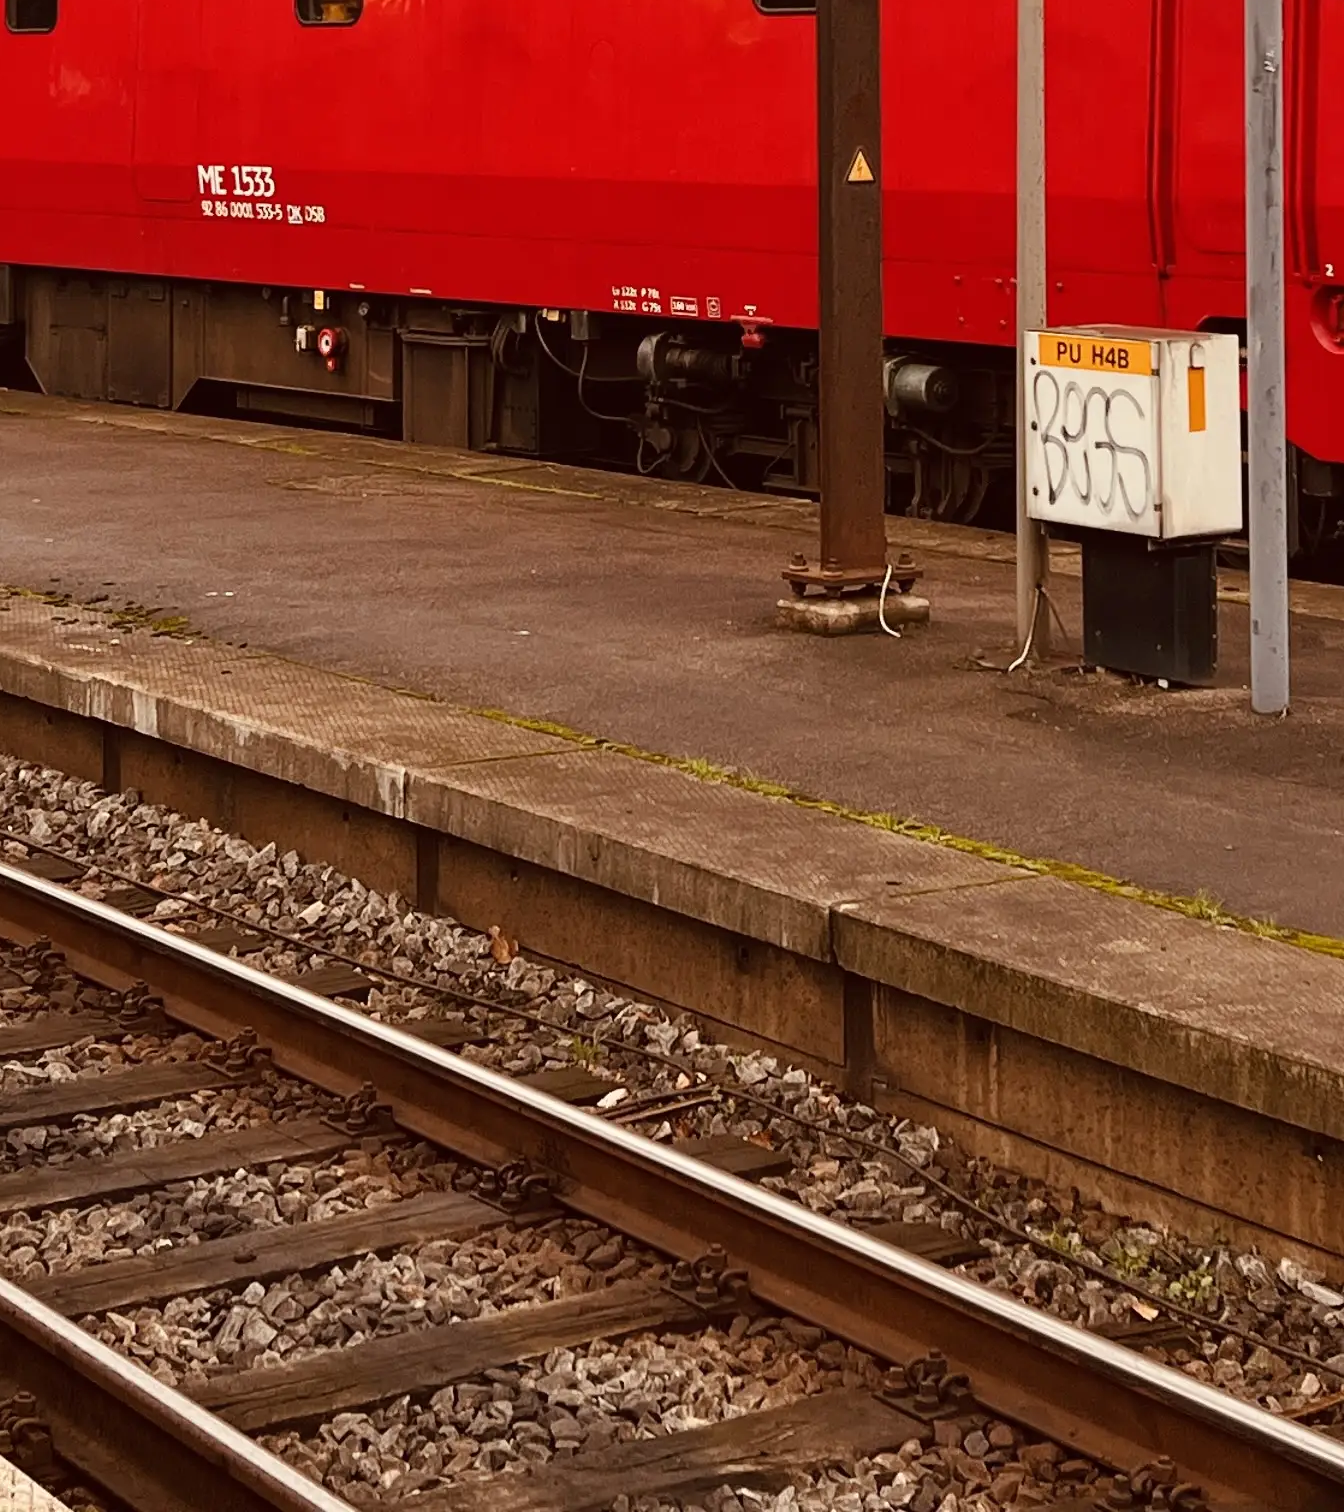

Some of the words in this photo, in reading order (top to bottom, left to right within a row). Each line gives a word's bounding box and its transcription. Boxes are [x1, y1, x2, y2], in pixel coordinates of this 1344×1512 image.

[197, 164, 227, 195] ME
[231, 165, 275, 198] 1533
[215, 200, 228, 217] 86
[256, 202, 283, 221] 533-5
[287, 204, 303, 224] DK
[304, 206, 325, 223] DSB
[1325, 263, 1334, 277] 2
[1057, 341, 1081, 364] PU
[1091, 344, 1129, 369] H4B
